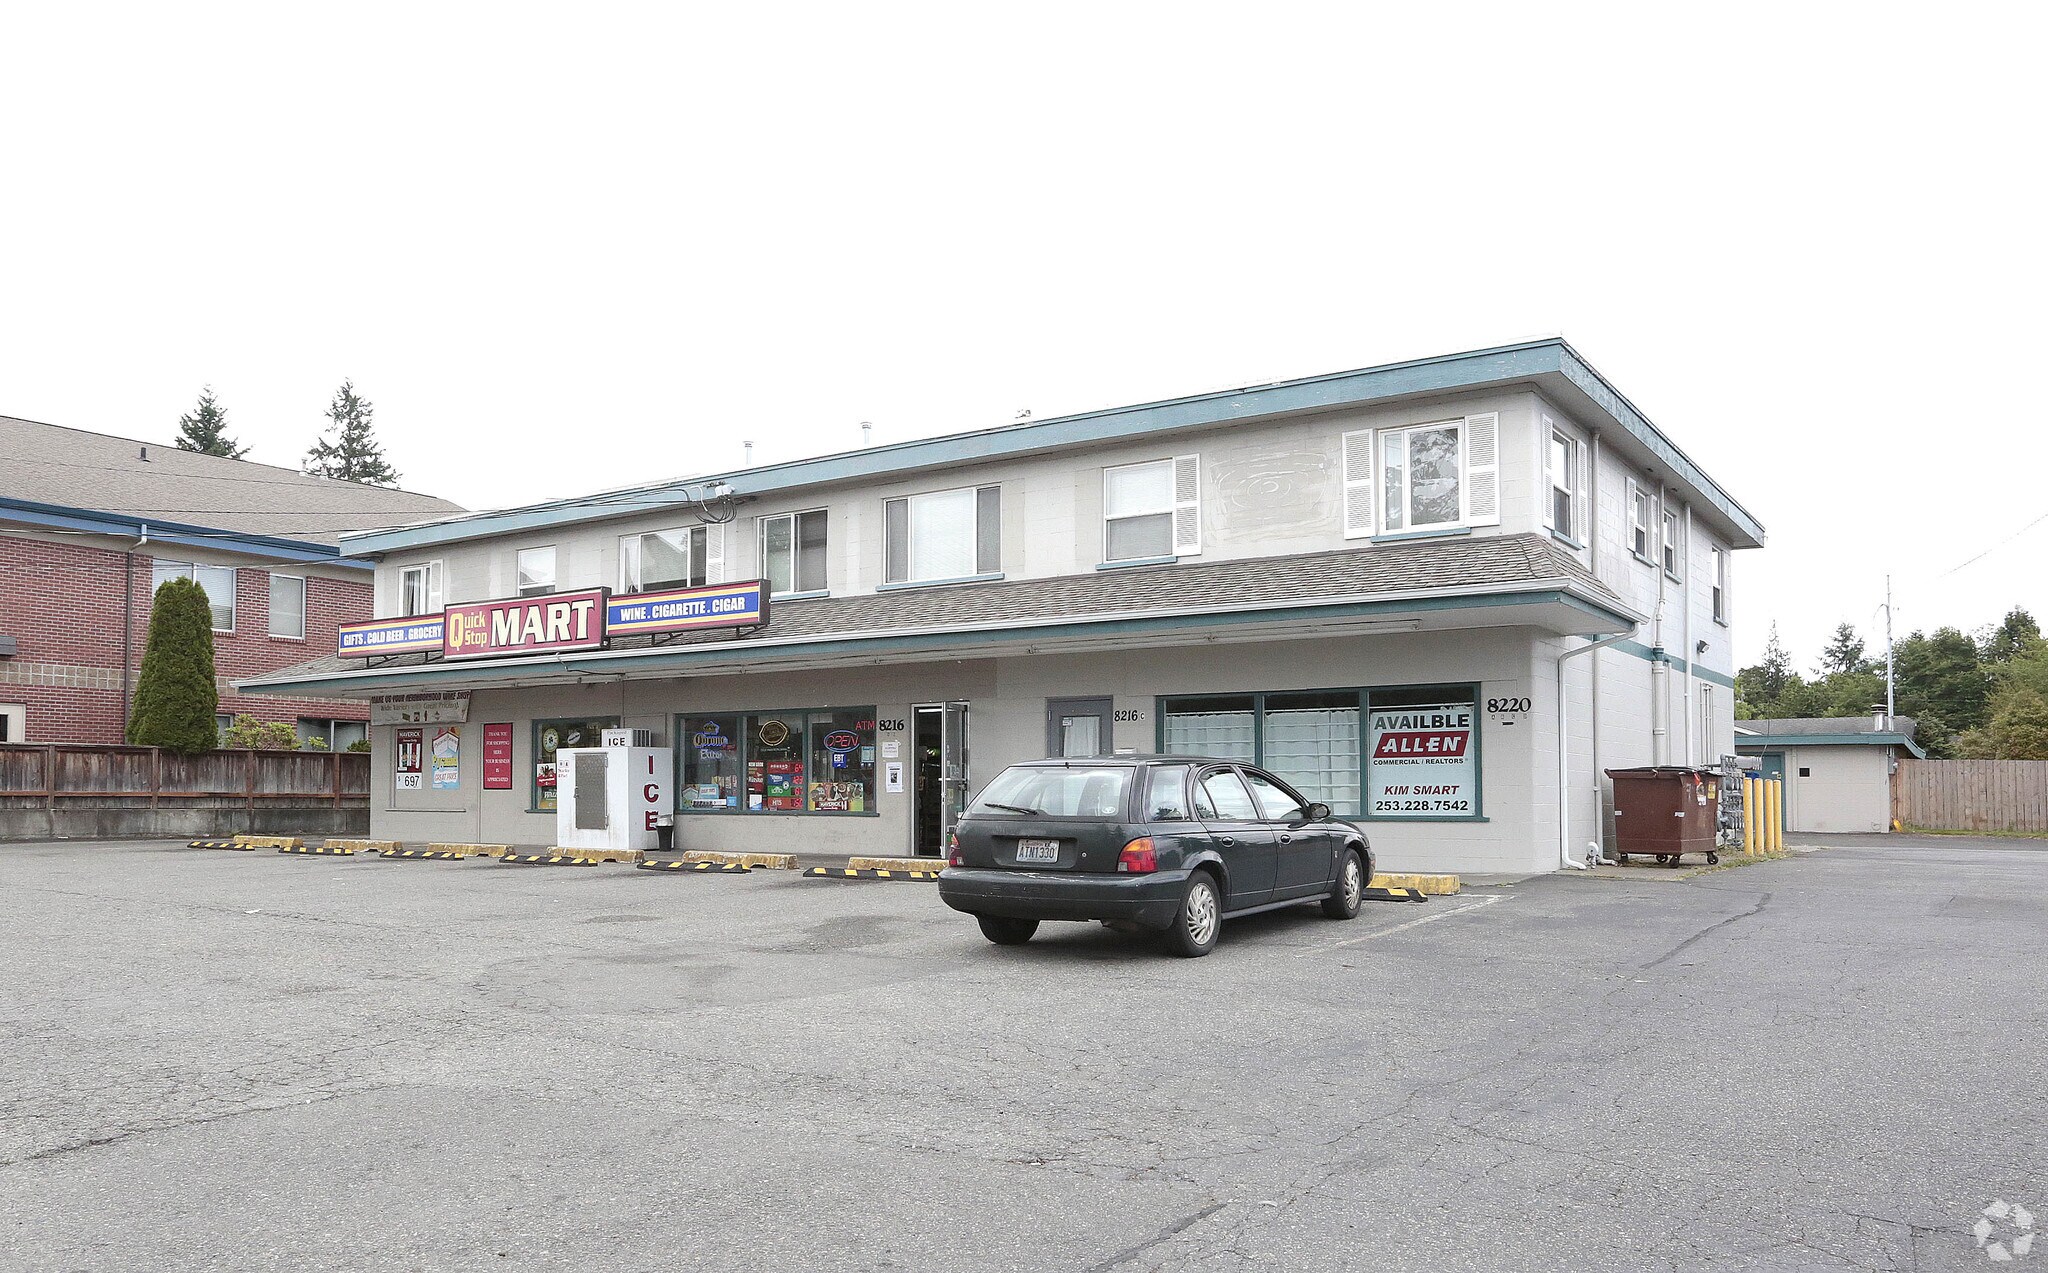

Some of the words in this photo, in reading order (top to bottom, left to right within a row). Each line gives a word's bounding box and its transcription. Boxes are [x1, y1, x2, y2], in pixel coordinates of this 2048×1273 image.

[620, 605, 646, 622] WINE
[652, 601, 705, 619] CIGARETTE
[712, 597, 745, 613] CIGAR
[490, 600, 594, 647] MART
[343, 632, 363, 646] GIFTS
[367, 631, 385, 644] COLD
[386, 629, 404, 642] BEER
[408, 625, 443, 640] GROCERY
[449, 612, 485, 651] Quick
[465, 631, 487, 647] Stop
[1487, 698, 1531, 713] 8220
[1114, 710, 1138, 721] 8216
[1374, 714, 1470, 730] AVAILBLE
[855, 721, 875, 730] ATM
[879, 719, 904, 731] 8216
[608, 738, 625, 747] ICE
[826, 735, 859, 747] OPEN
[1382, 737, 1461, 753] ALLEN
[404, 775, 419, 786] 697
[644, 755, 659, 831] ICE
[1384, 786, 1410, 795] KIM
[1413, 785, 1459, 795] SMART
[1376, 801, 1468, 812] 253.228.7542
